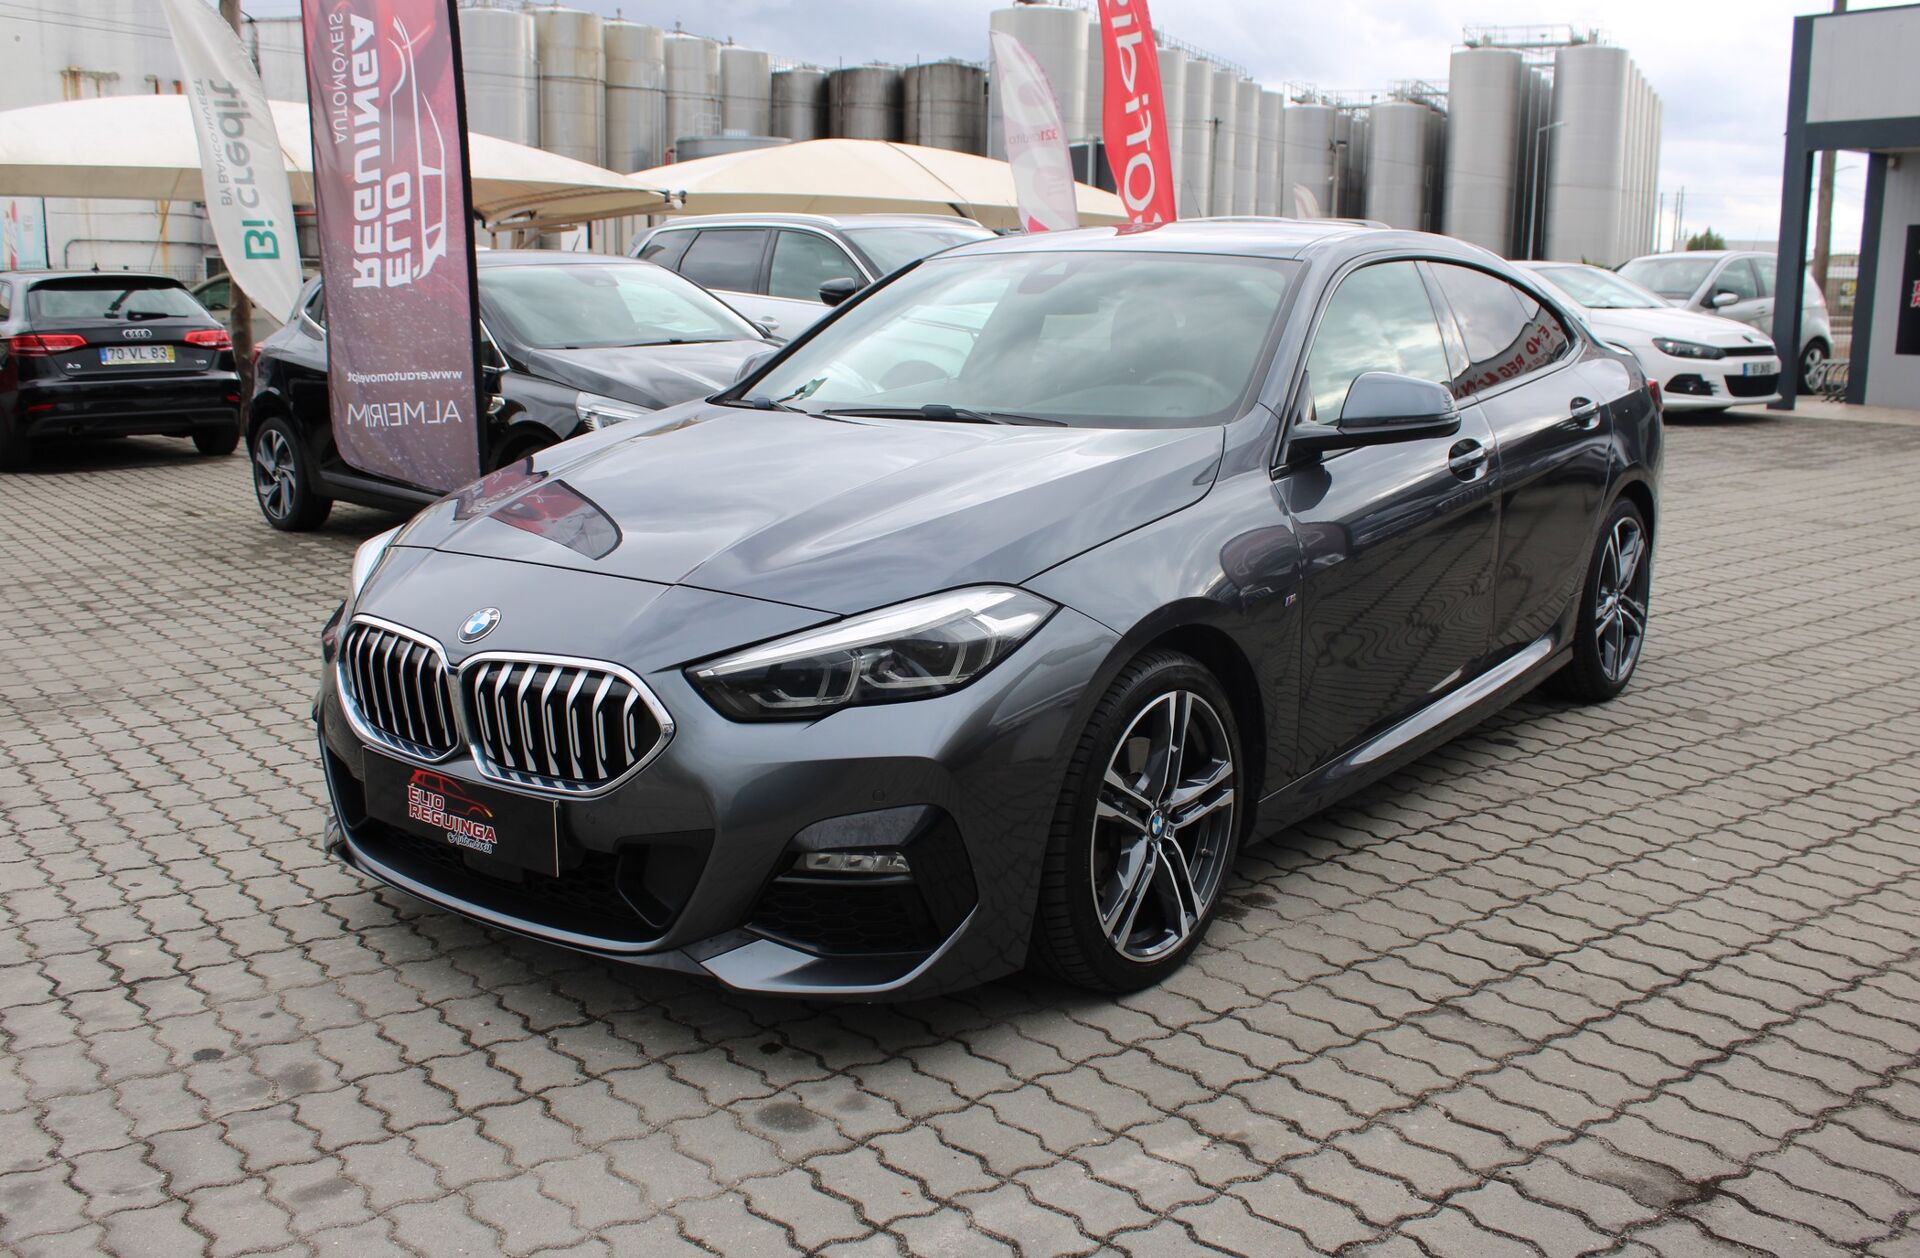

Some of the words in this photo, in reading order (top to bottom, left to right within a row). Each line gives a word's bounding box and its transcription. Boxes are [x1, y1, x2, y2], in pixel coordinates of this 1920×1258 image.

[128, 347, 147, 359] VL
[151, 346, 168, 358] 83
[408, 801, 498, 845] REGUINGA
